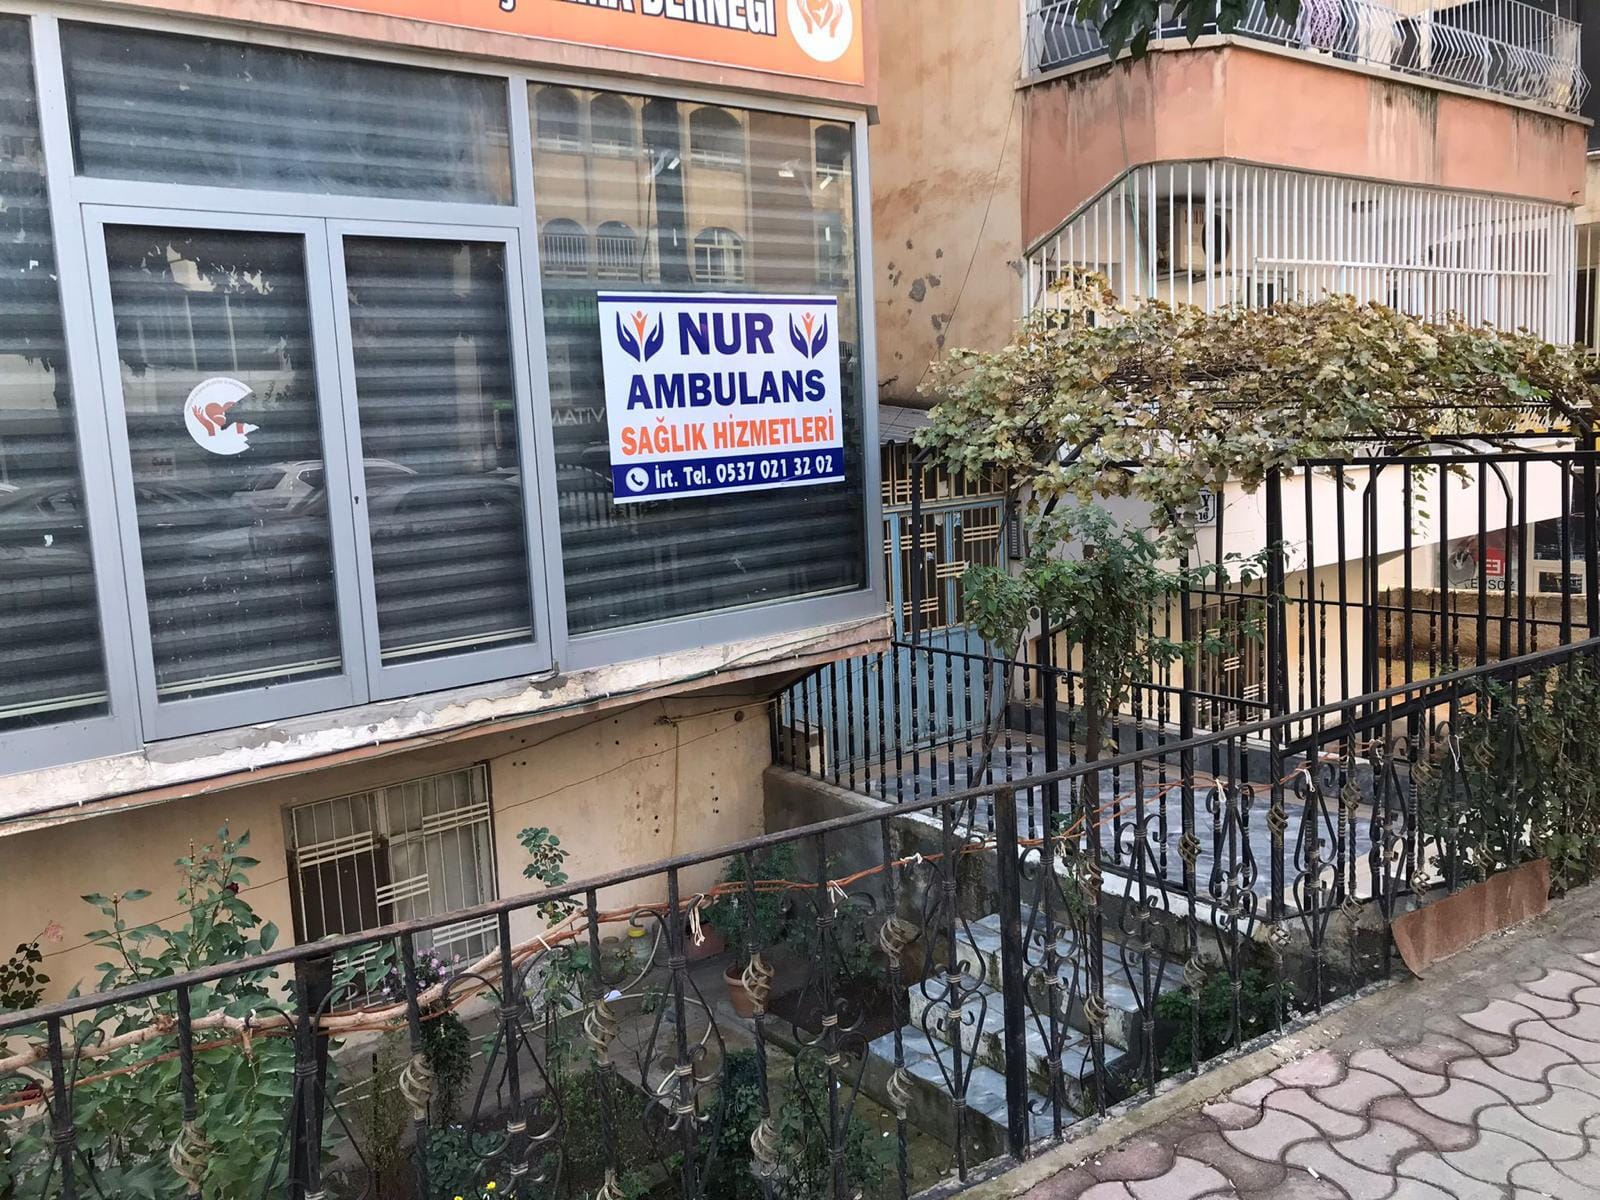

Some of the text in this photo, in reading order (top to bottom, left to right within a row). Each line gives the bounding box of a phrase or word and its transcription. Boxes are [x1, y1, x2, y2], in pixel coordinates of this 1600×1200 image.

[678, 312, 775, 355] NUR
[627, 369, 826, 410] AMBULANS
[620, 408, 835, 457] SAĞLIK HİZMETLERİ
[682, 466, 711, 486] Tel.
[715, 462, 755, 483] 0537
[759, 459, 788, 480] 021
[793, 457, 812, 477] 32
[814, 455, 834, 475] 02
